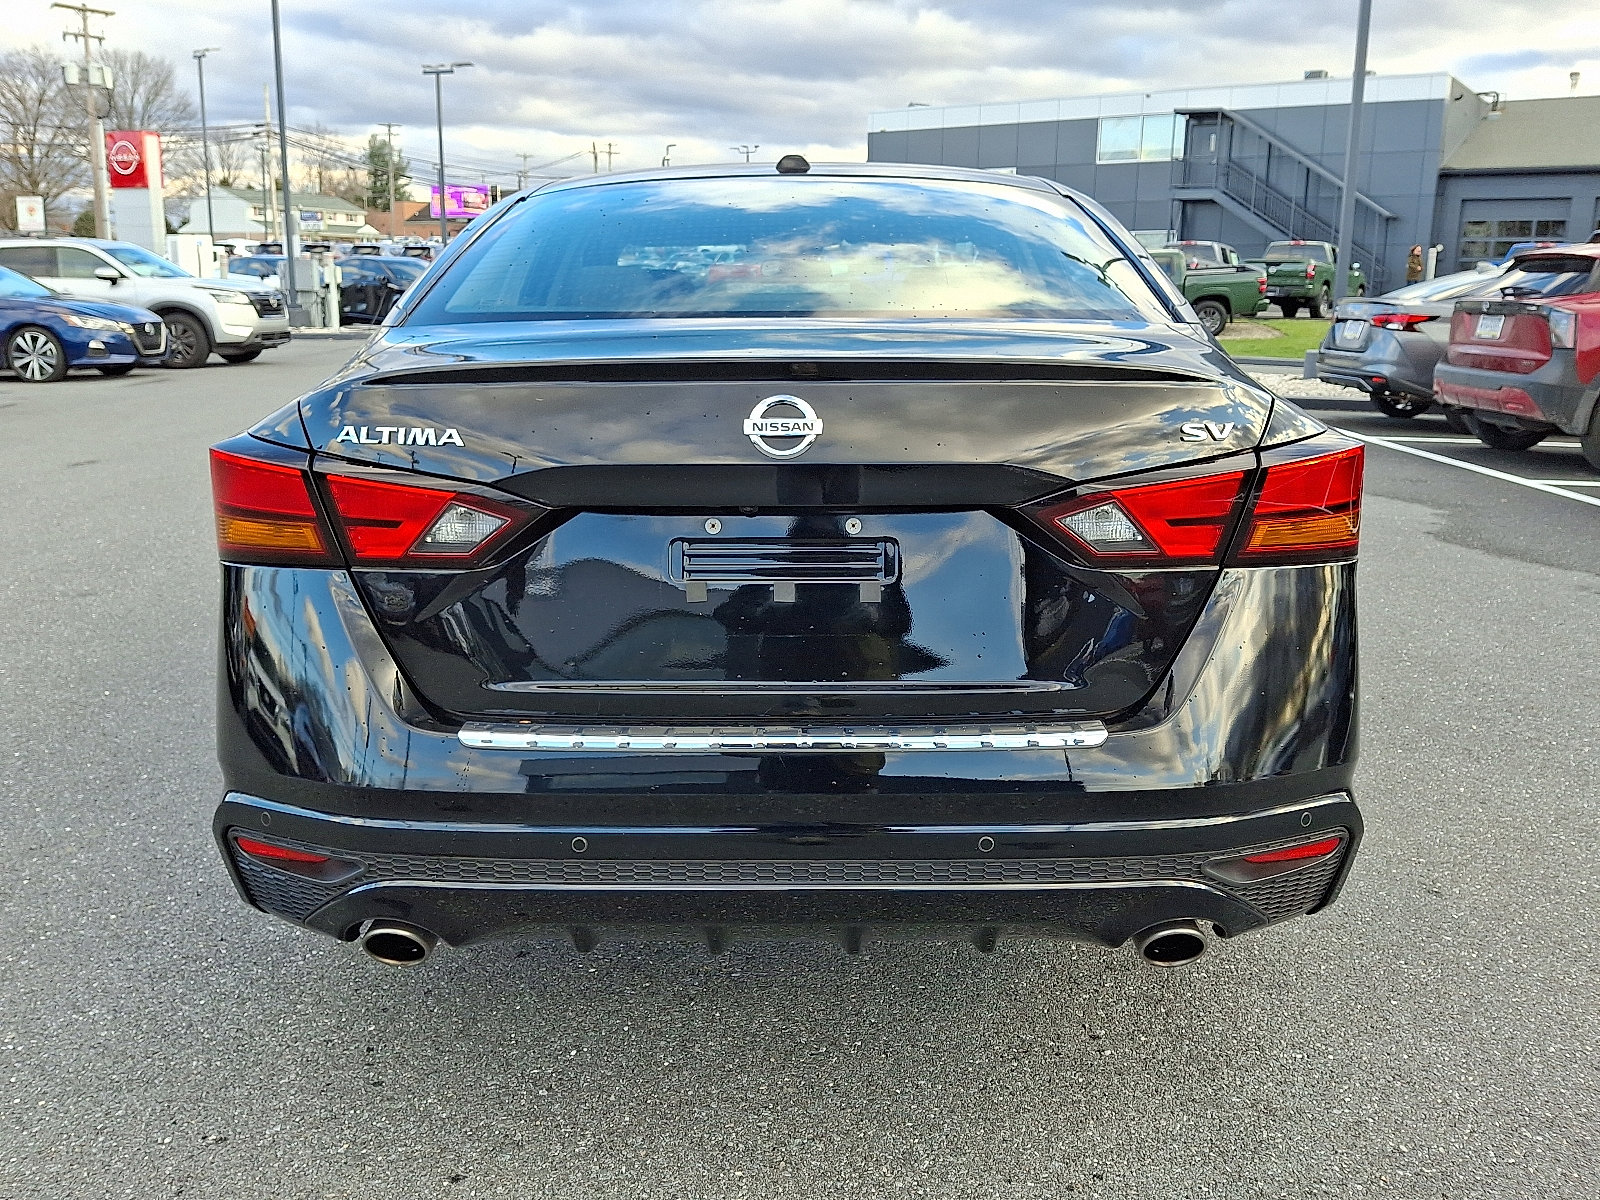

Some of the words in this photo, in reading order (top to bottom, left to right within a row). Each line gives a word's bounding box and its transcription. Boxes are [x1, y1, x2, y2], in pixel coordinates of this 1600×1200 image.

[335, 425, 466, 447] ALTIMA
[752, 423, 814, 432] NISSAN
[1180, 422, 1235, 442] SV
